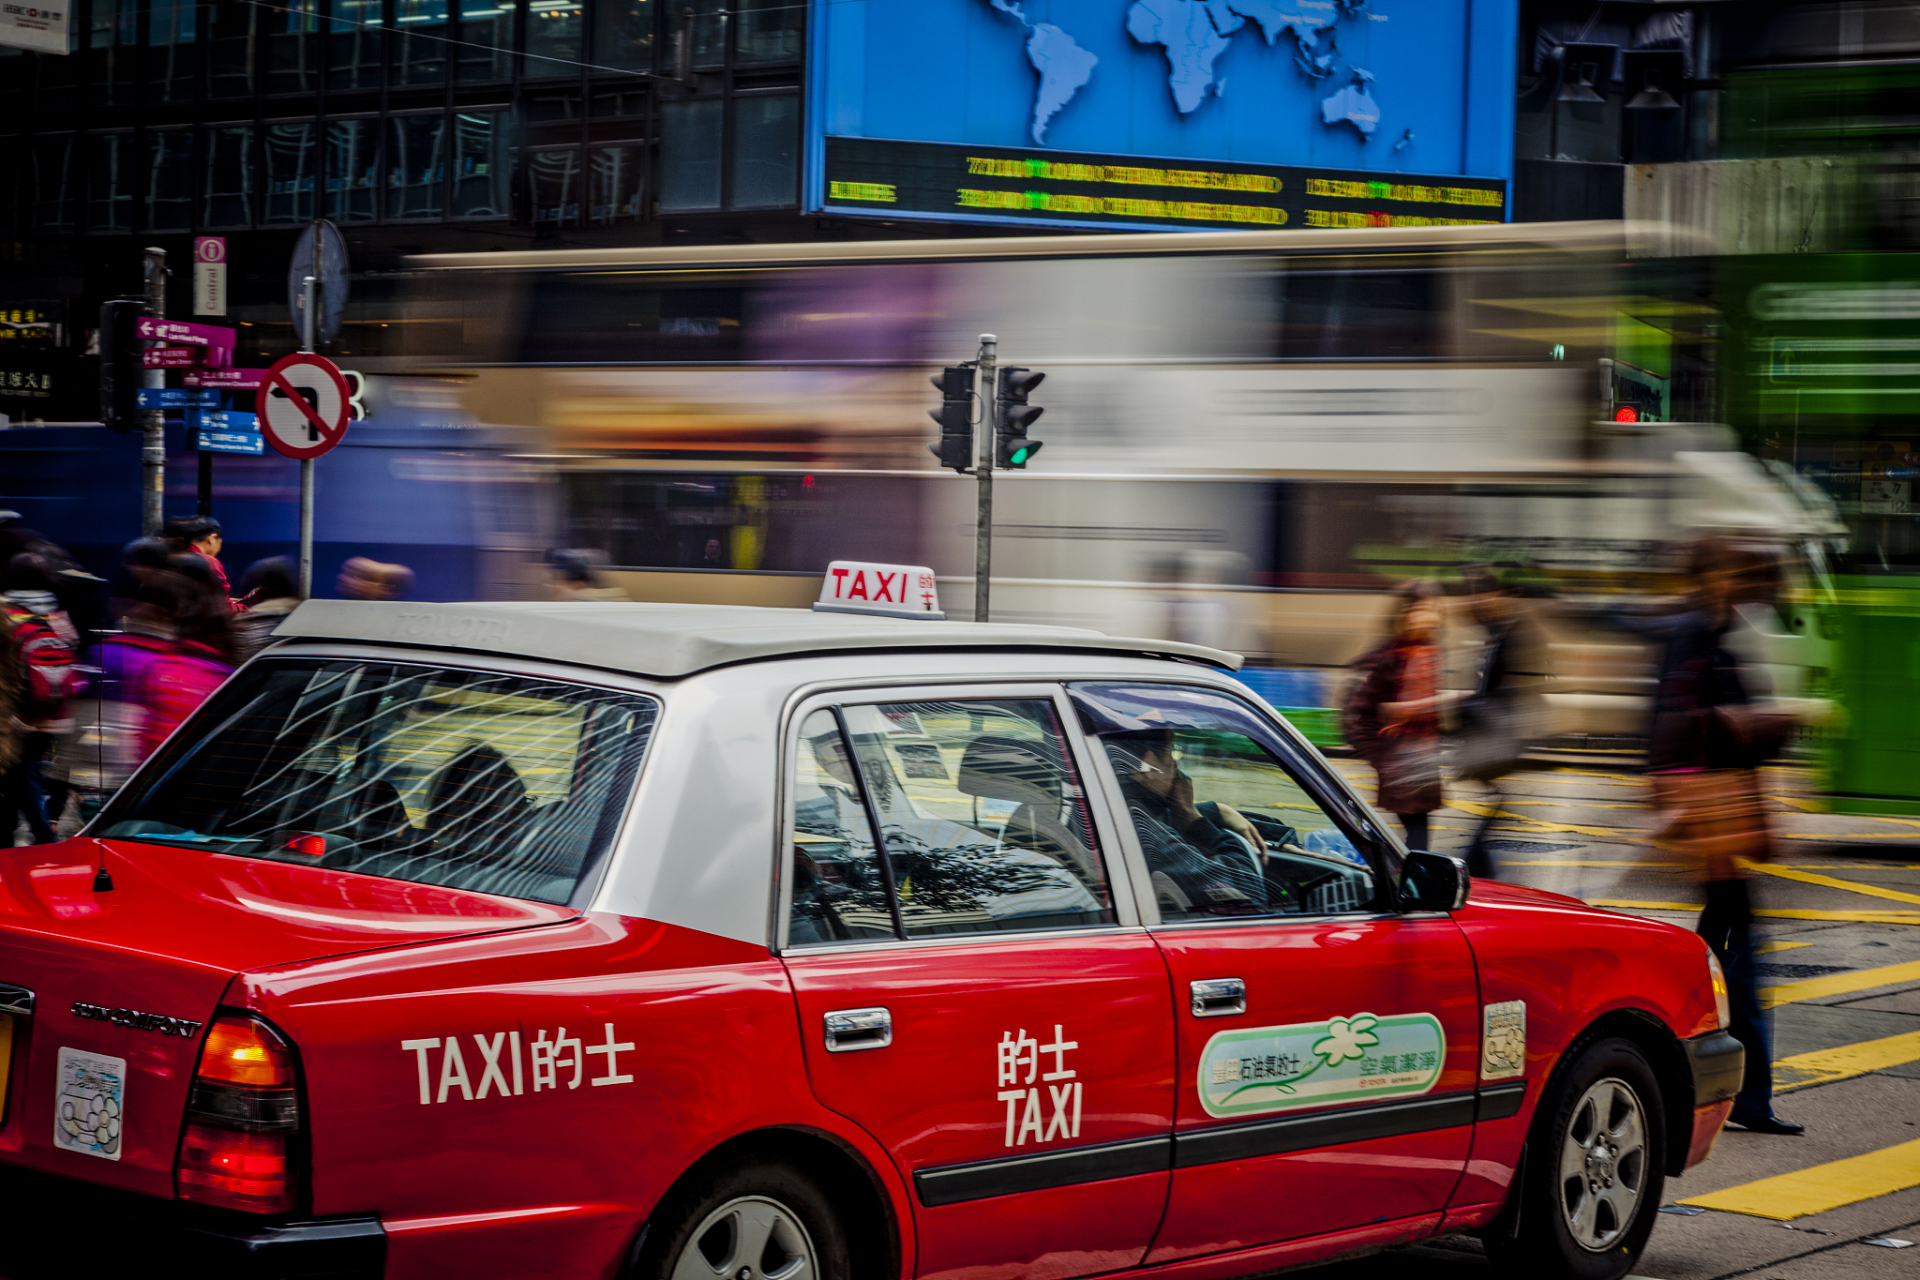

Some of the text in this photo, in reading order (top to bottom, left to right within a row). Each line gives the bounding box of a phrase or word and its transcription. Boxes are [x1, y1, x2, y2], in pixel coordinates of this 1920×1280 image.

[205, 268, 217, 310] Central
[832, 568, 907, 603] TAXI
[111, 1007, 203, 1039] COMFORT
[401, 1023, 636, 1105] TAXI 的士
[997, 1024, 1079, 1088] 的士
[997, 1082, 1083, 1148] TAXI
